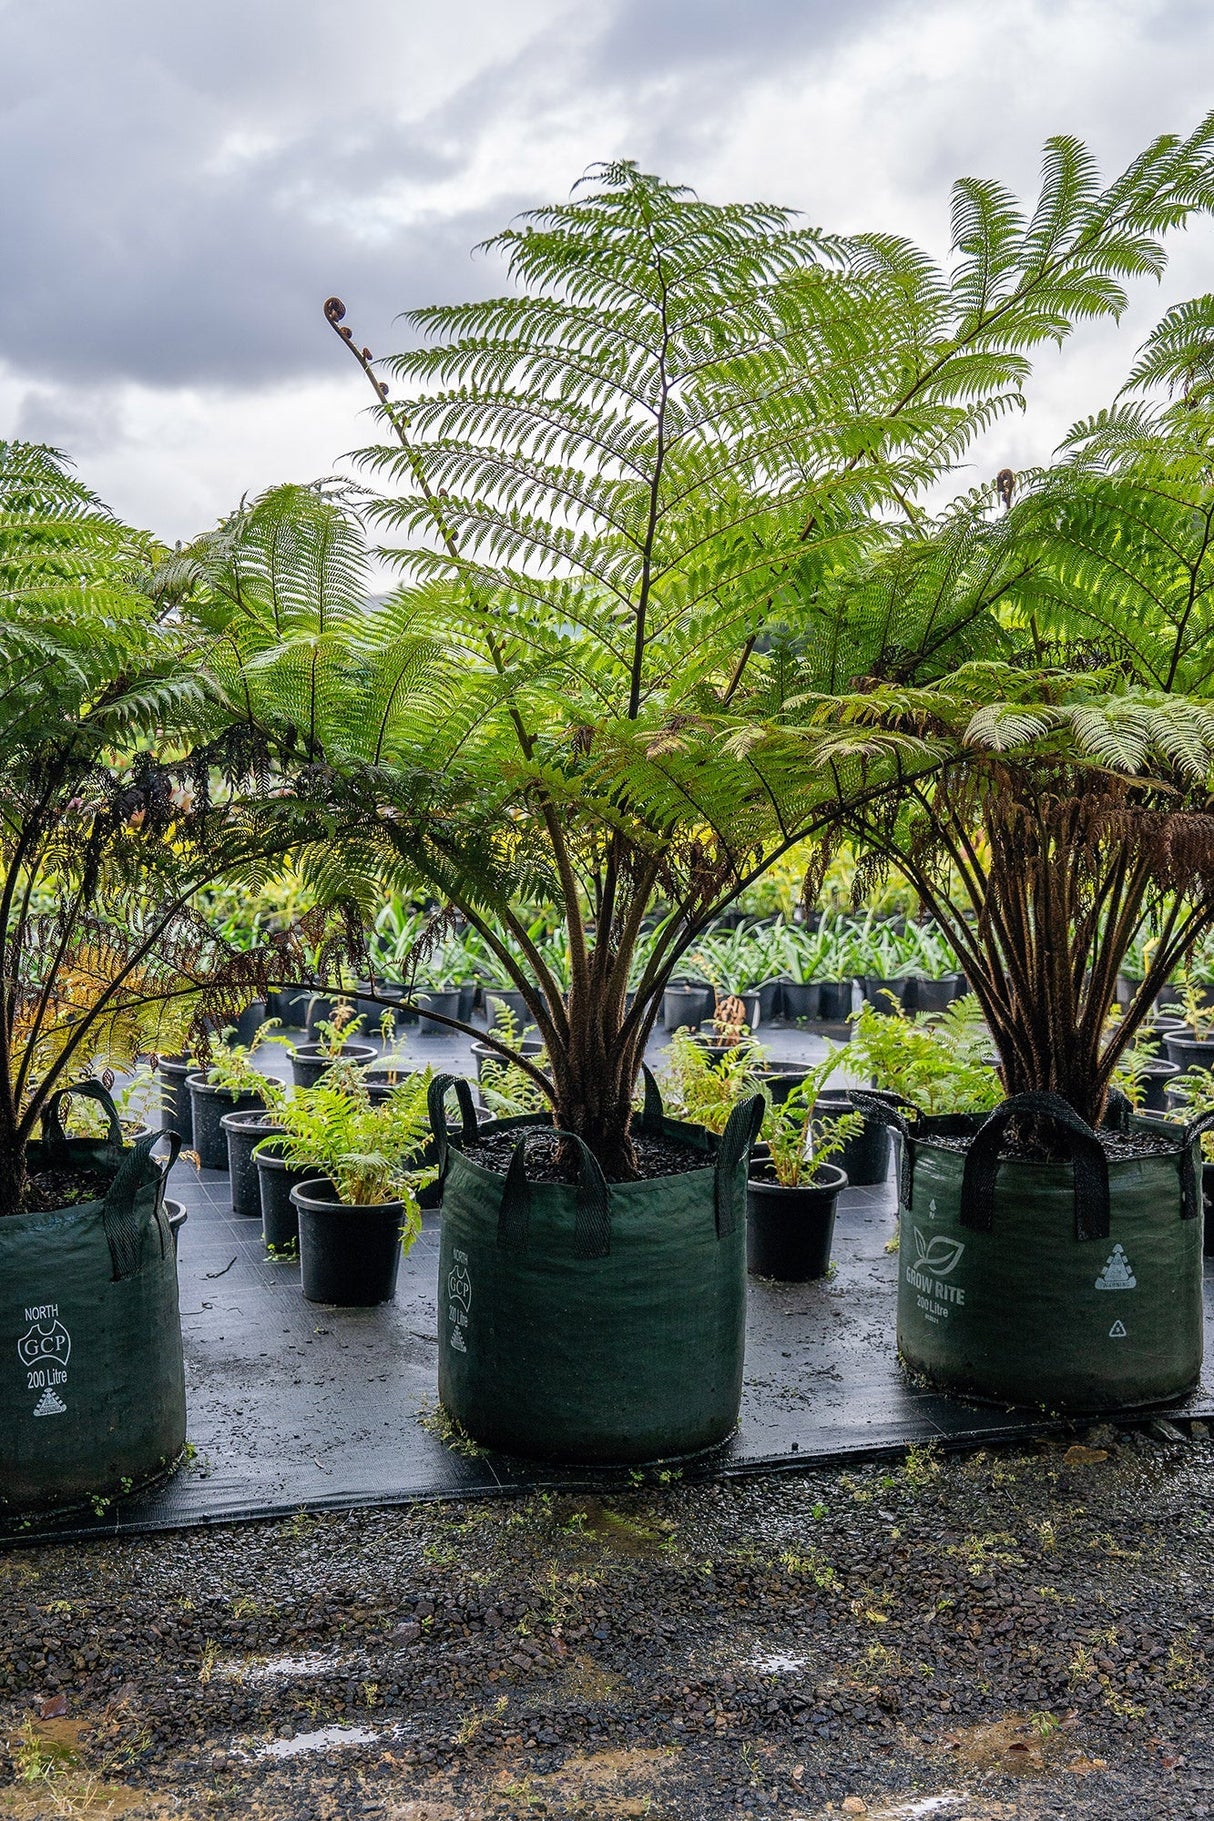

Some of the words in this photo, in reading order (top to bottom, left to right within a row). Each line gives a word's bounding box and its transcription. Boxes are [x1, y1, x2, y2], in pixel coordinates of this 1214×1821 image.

[450, 1276, 469, 1297] GCP
[906, 1266, 932, 1294] GROW
[935, 1281, 965, 1306] RITE
[25, 1304, 59, 1321] NORTH
[917, 1295, 929, 1311] 200
[930, 1300, 949, 1318] Litre
[24, 1335, 66, 1356] GCP
[27, 1370, 45, 1389] 200
[47, 1368, 67, 1386] Litre
